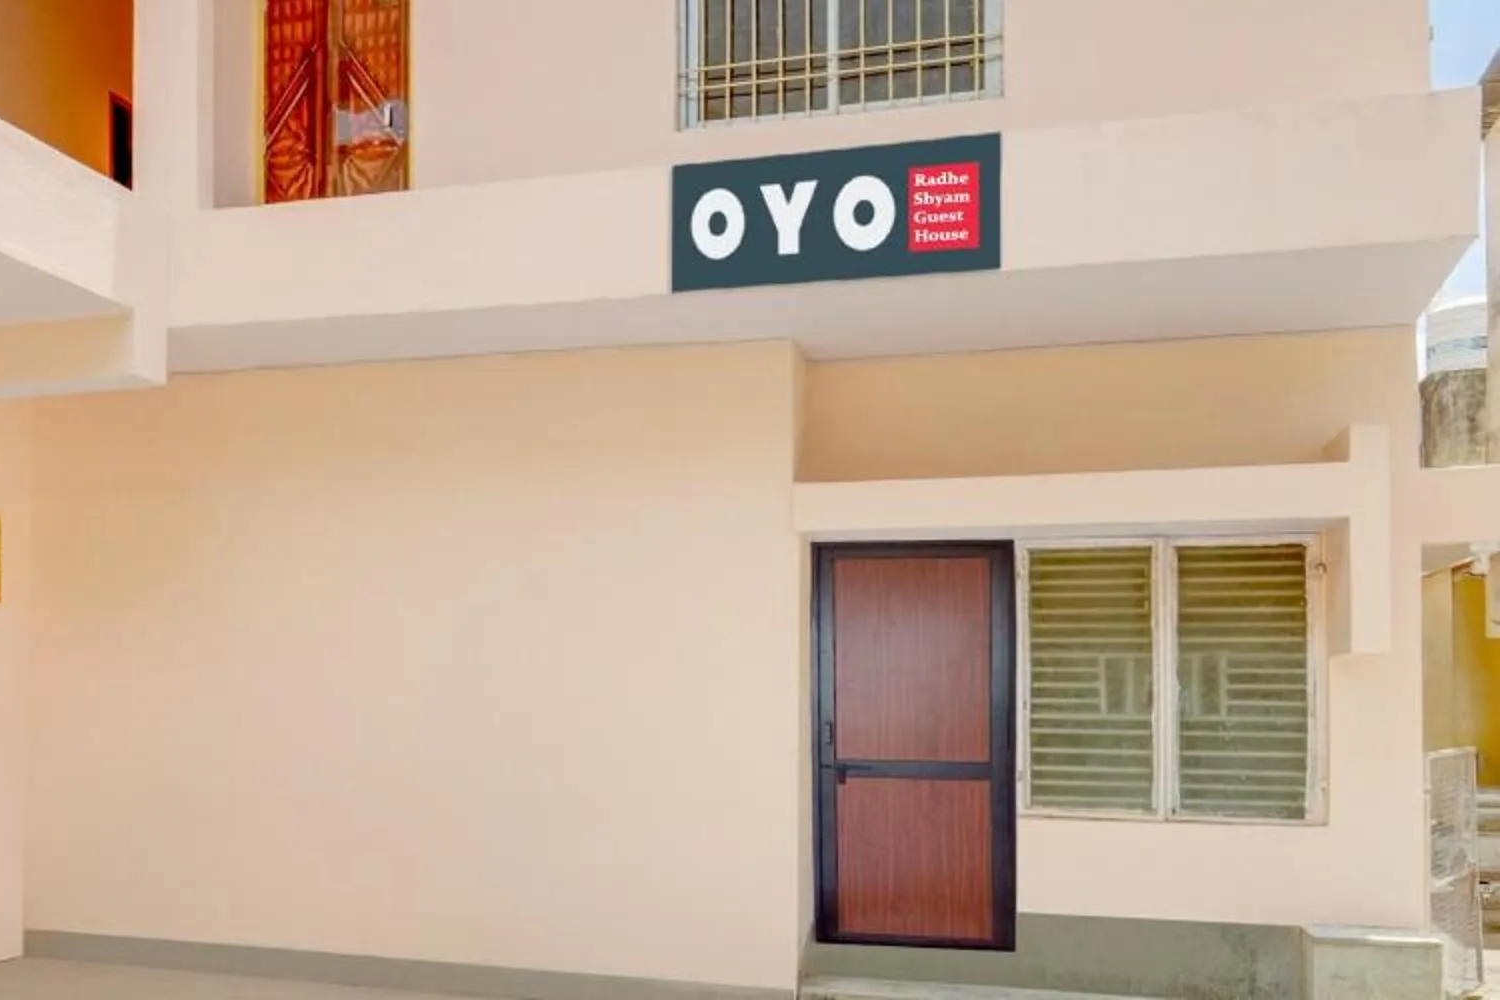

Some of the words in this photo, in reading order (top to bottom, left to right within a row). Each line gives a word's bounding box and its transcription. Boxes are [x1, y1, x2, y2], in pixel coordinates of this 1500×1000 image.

[914, 172, 969, 187] Radhe
[914, 191, 970, 207] Shyam
[690, 175, 896, 260] OYO
[914, 210, 964, 225] Guest
[914, 228, 969, 243] House
